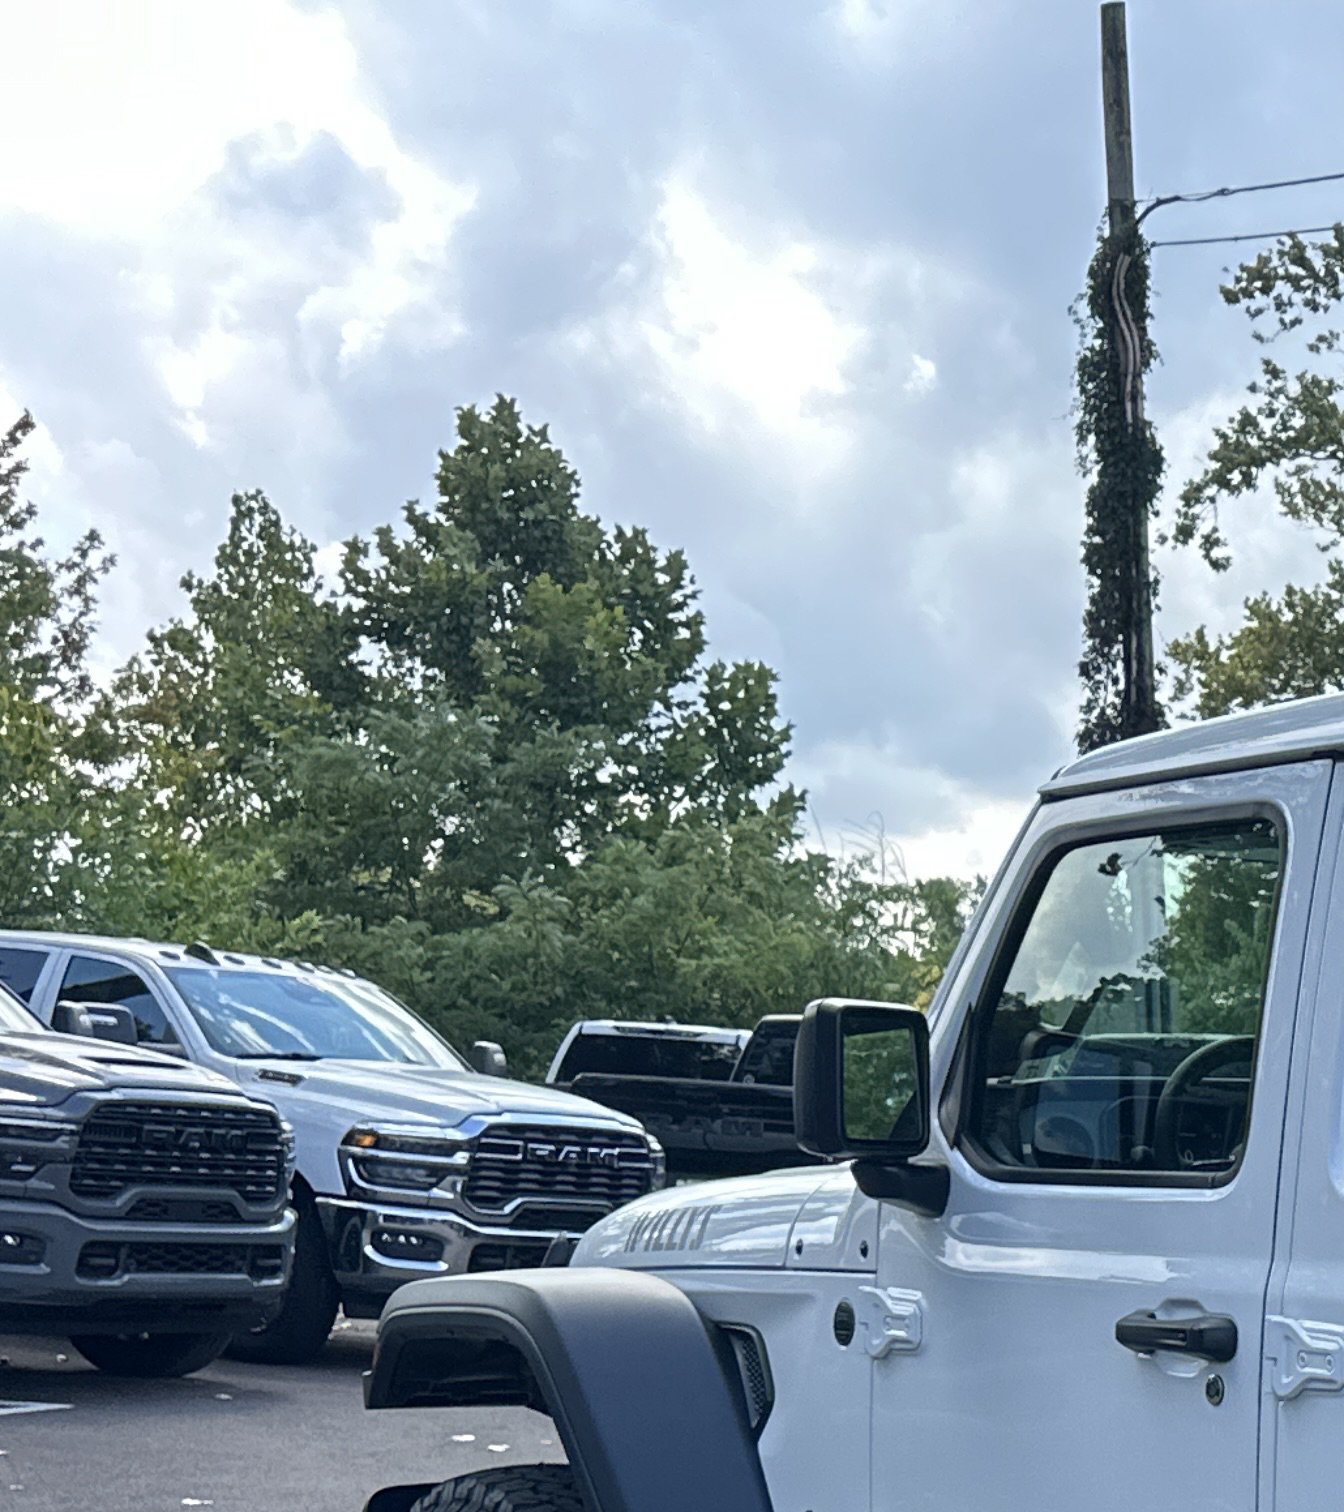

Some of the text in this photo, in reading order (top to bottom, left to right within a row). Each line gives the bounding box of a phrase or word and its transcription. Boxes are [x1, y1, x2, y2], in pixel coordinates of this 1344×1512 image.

[142, 1123, 247, 1148] RAM
[526, 1143, 619, 1169] RAM
[623, 1203, 722, 1253] WILLYS
